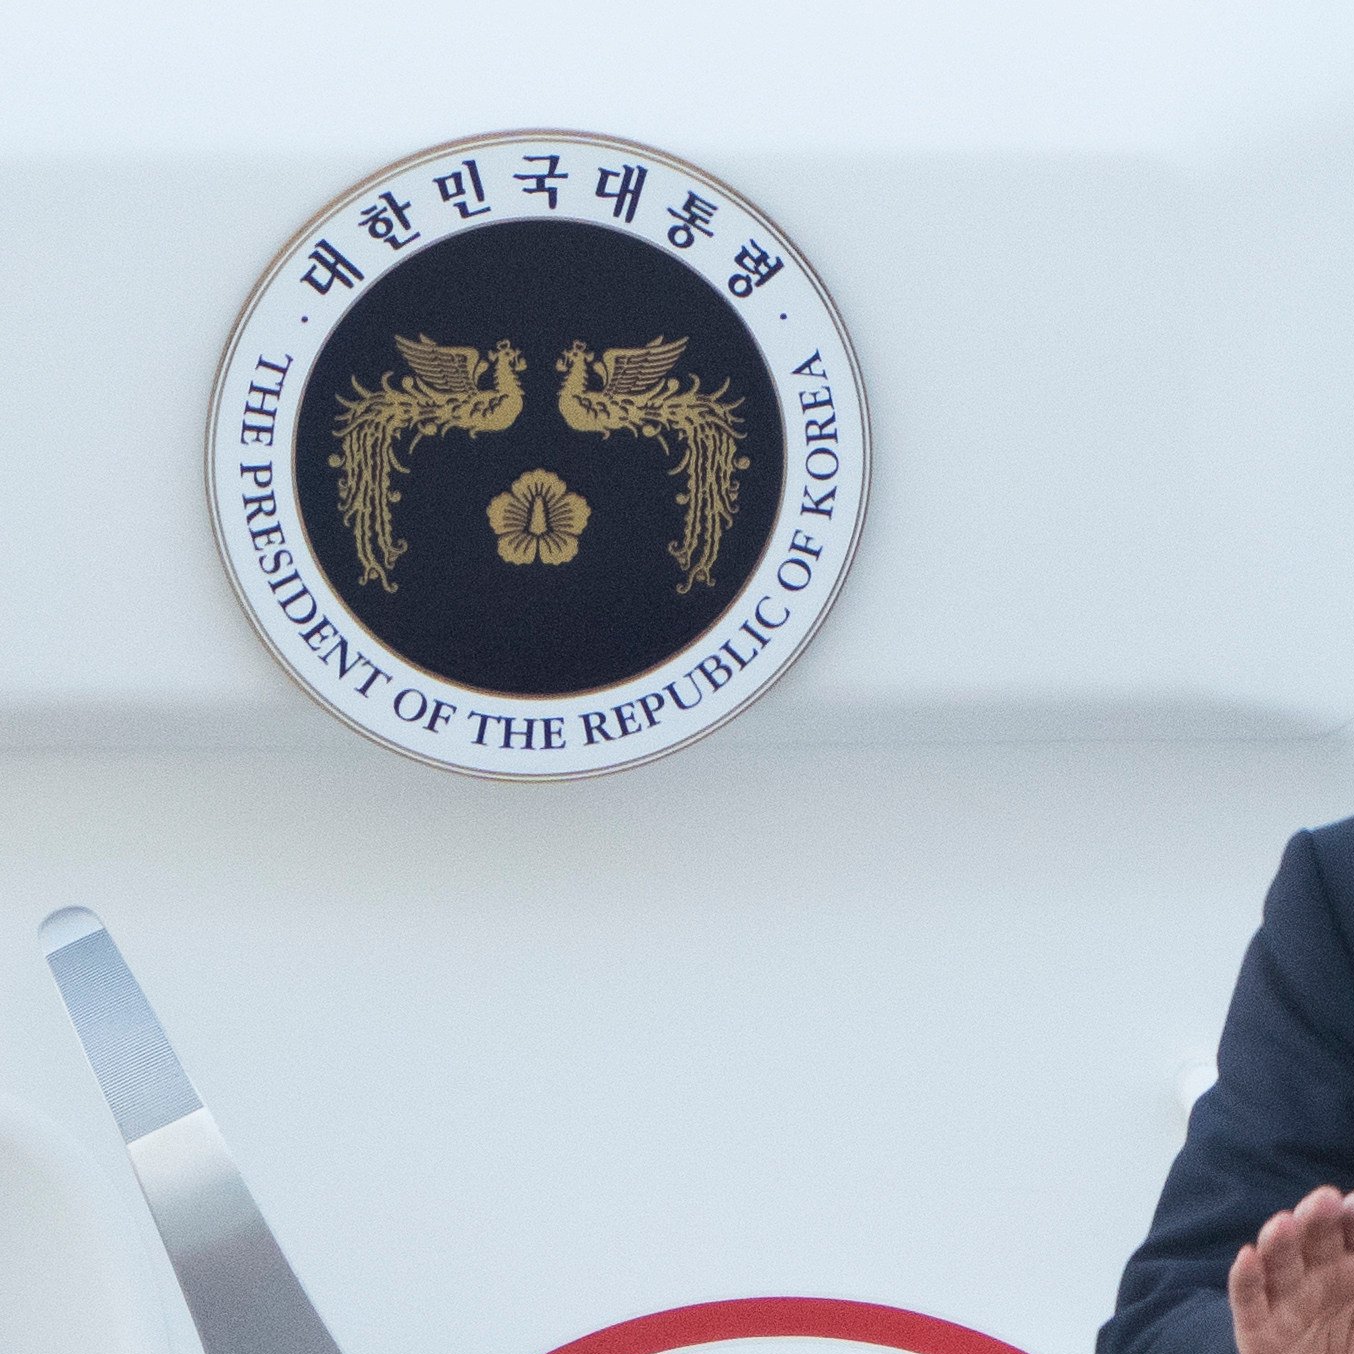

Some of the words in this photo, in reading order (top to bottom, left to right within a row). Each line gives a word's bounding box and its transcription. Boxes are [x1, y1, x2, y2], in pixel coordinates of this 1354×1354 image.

[240, 353, 294, 447] THE
[791, 348, 840, 521] KOREA
[240, 460, 393, 699] PRESIDENT
[776, 528, 823, 592] OF
[393, 688, 458, 734] OF
[578, 595, 791, 747] REPUBLIC
[467, 710, 567, 751] THE
